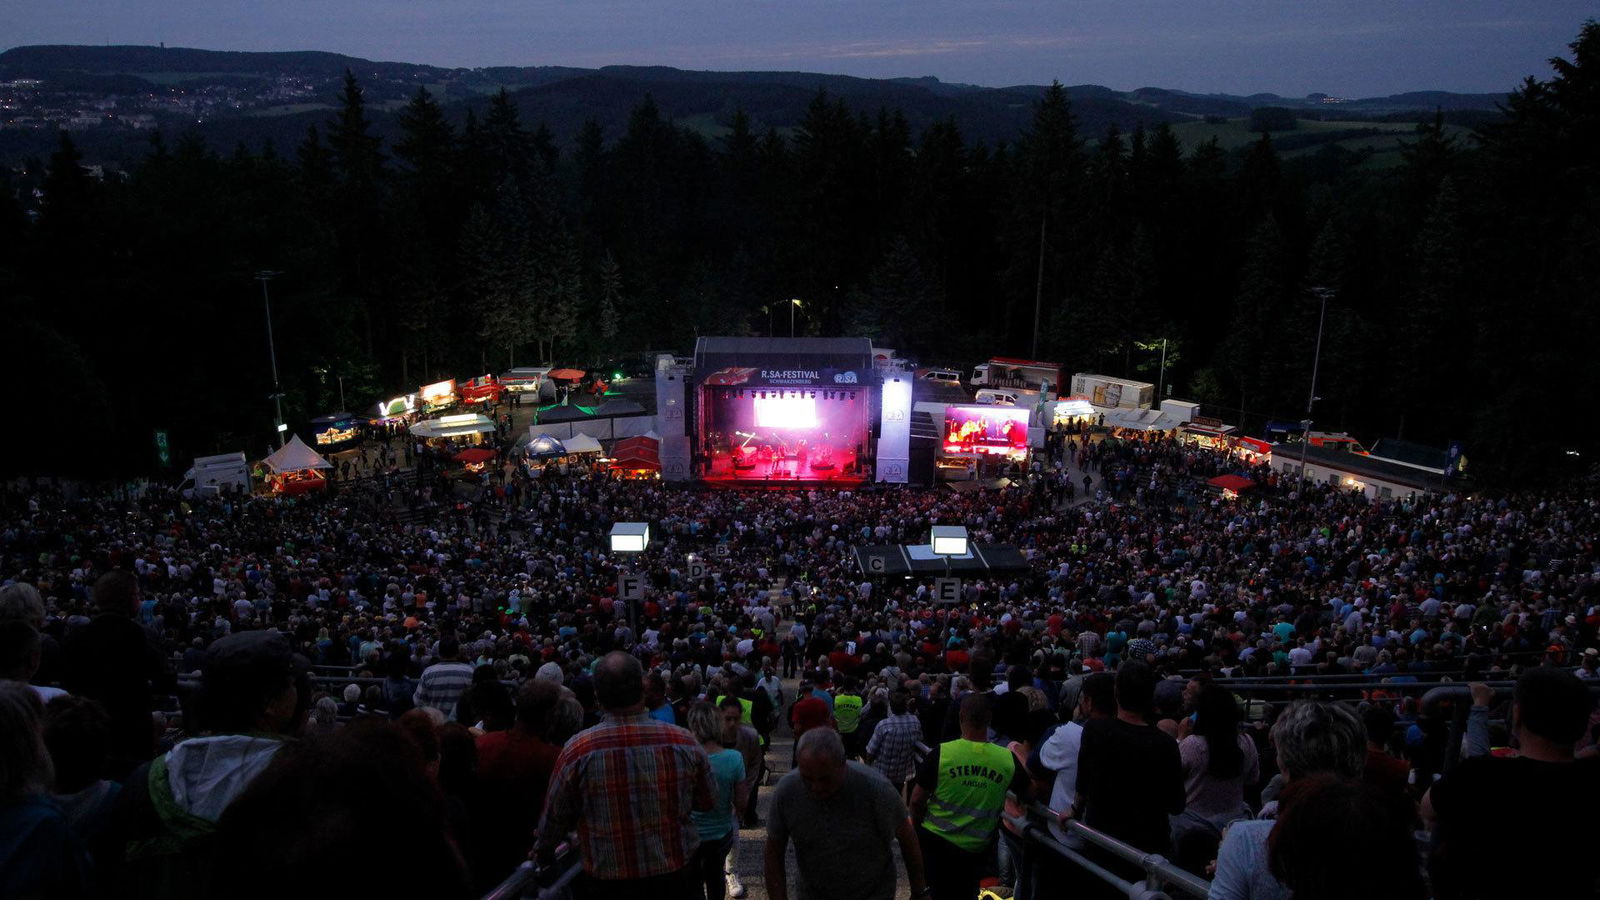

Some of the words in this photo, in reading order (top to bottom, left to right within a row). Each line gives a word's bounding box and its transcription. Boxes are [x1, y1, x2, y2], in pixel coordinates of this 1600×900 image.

[761, 370, 820, 379] R.SA-FESTIVAL
[718, 546, 726, 555] B
[871, 558, 882, 570] C
[692, 565, 702, 577] D
[624, 579, 638, 597] F
[940, 582, 955, 600] E
[949, 765, 1003, 784] STEWARD
